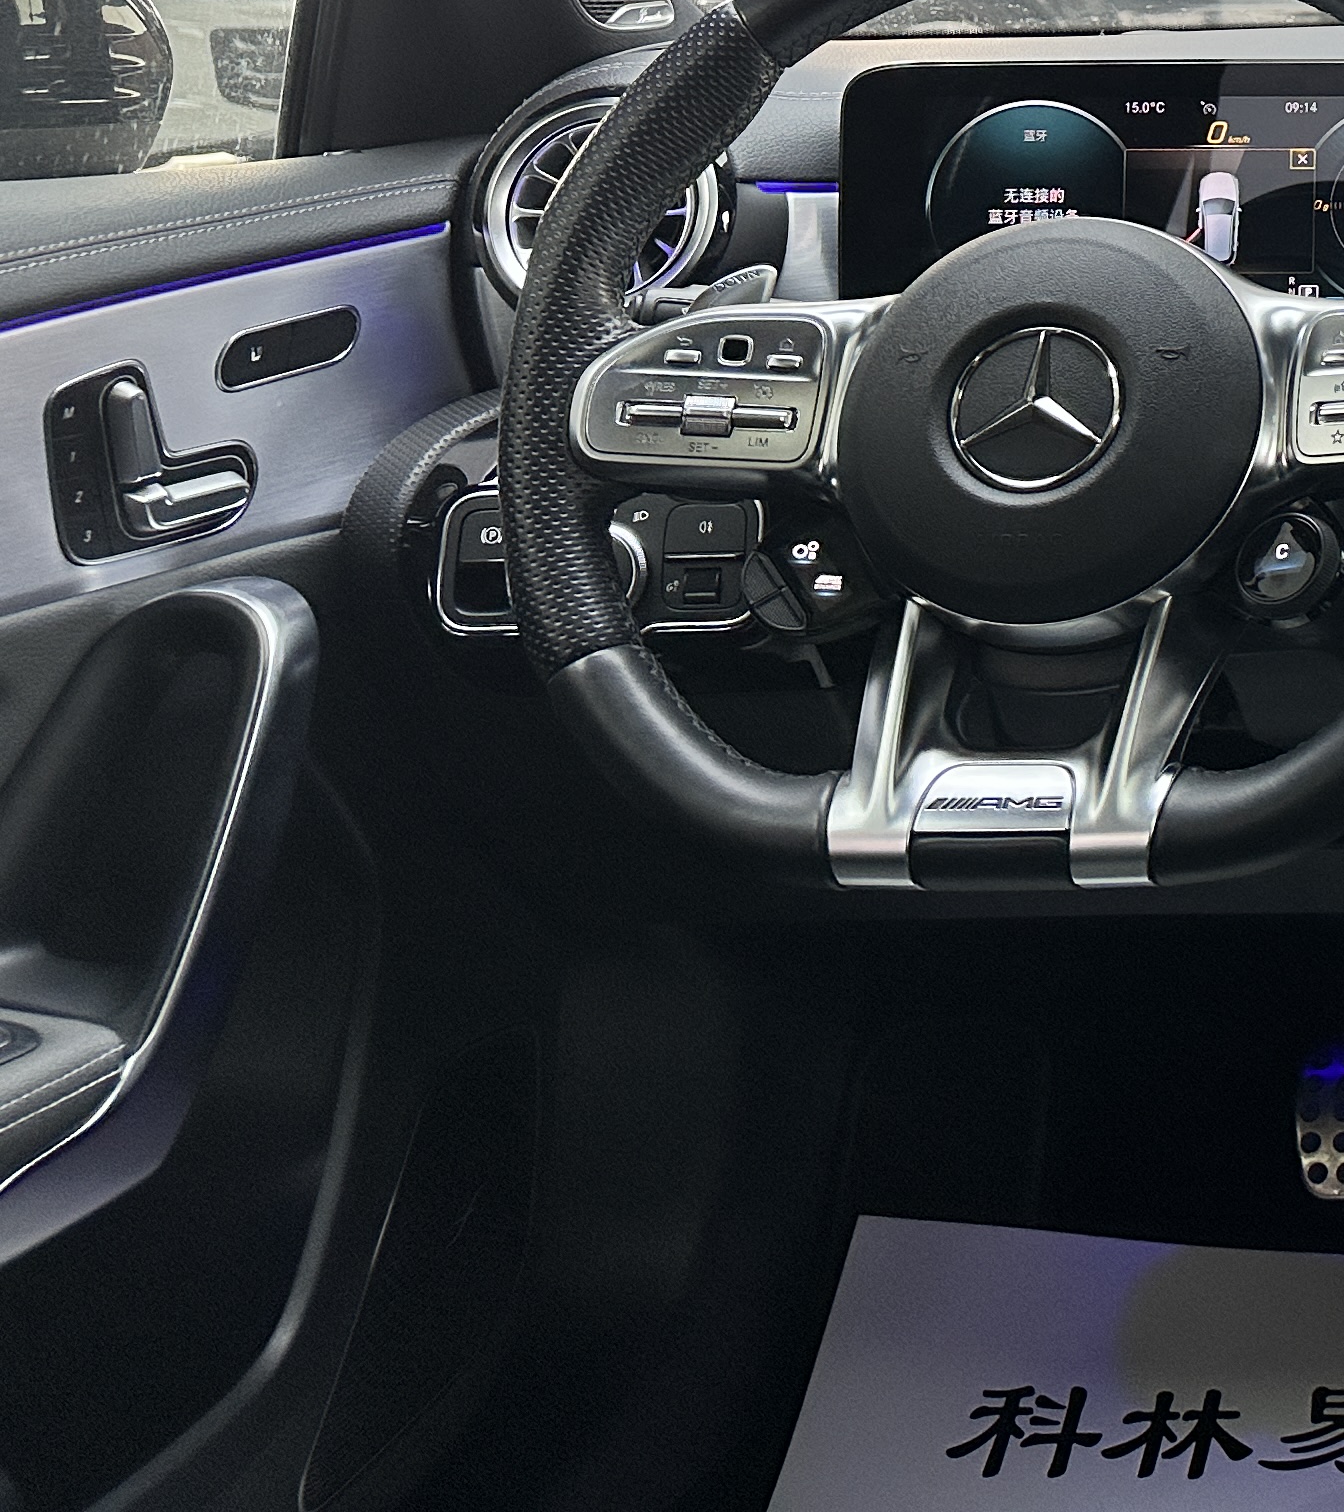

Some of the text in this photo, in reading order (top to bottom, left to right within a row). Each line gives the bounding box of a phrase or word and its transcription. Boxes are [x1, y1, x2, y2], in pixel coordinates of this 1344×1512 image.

[1124, 101, 1166, 114] 15.0°C
[1284, 101, 1318, 114] 09:14
[1024, 130, 1047, 142] 蓝牙
[1004, 188, 1065, 203] 无连接的
[713, 270, 761, 292] DOWN
[748, 436, 769, 448] LIM
[971, 796, 1064, 810] AMG
